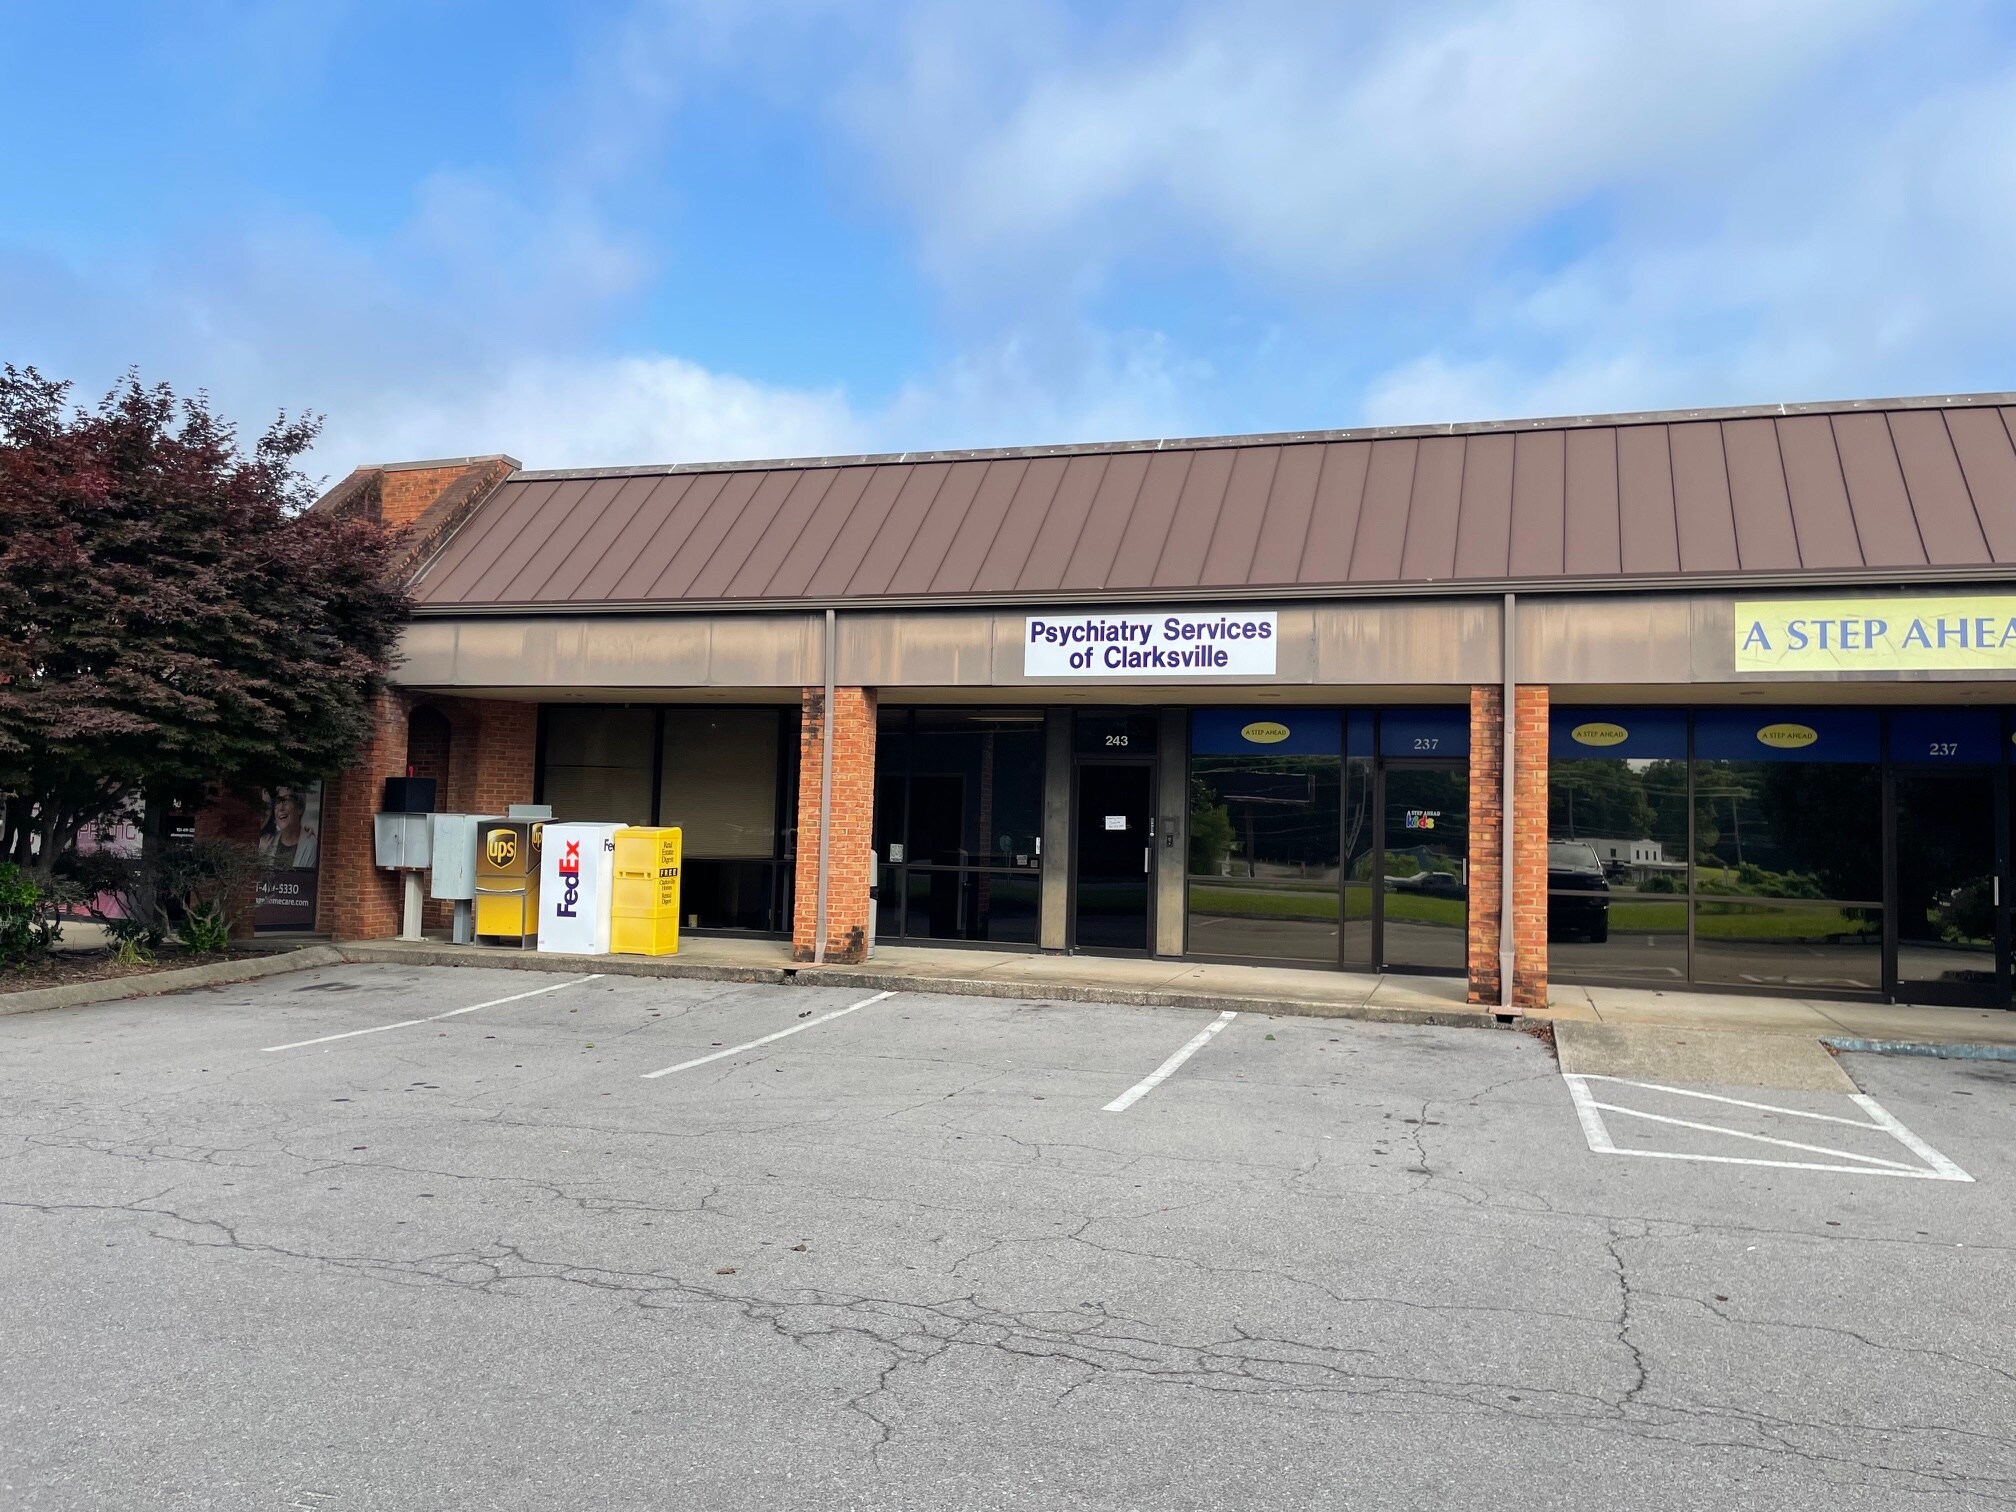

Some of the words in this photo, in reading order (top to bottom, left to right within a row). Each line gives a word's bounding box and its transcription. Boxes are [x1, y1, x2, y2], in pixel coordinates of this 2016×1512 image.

[1031, 620, 1152, 646] Psychiatry
[1163, 617, 1272, 641] Services
[1742, 621, 1772, 650] A
[1787, 619, 1888, 651] STEP
[1069, 647, 1093, 669] of
[1104, 645, 1228, 669] Clarksville
[1105, 735, 1128, 746] 243
[1414, 738, 1439, 750] 237
[1929, 743, 1958, 756] 237
[1406, 814, 1435, 829] kids
[489, 841, 515, 863] ups
[603, 839, 615, 852] Fe
[661, 856, 674, 864] Digest
[556, 840, 580, 917] FedEx
